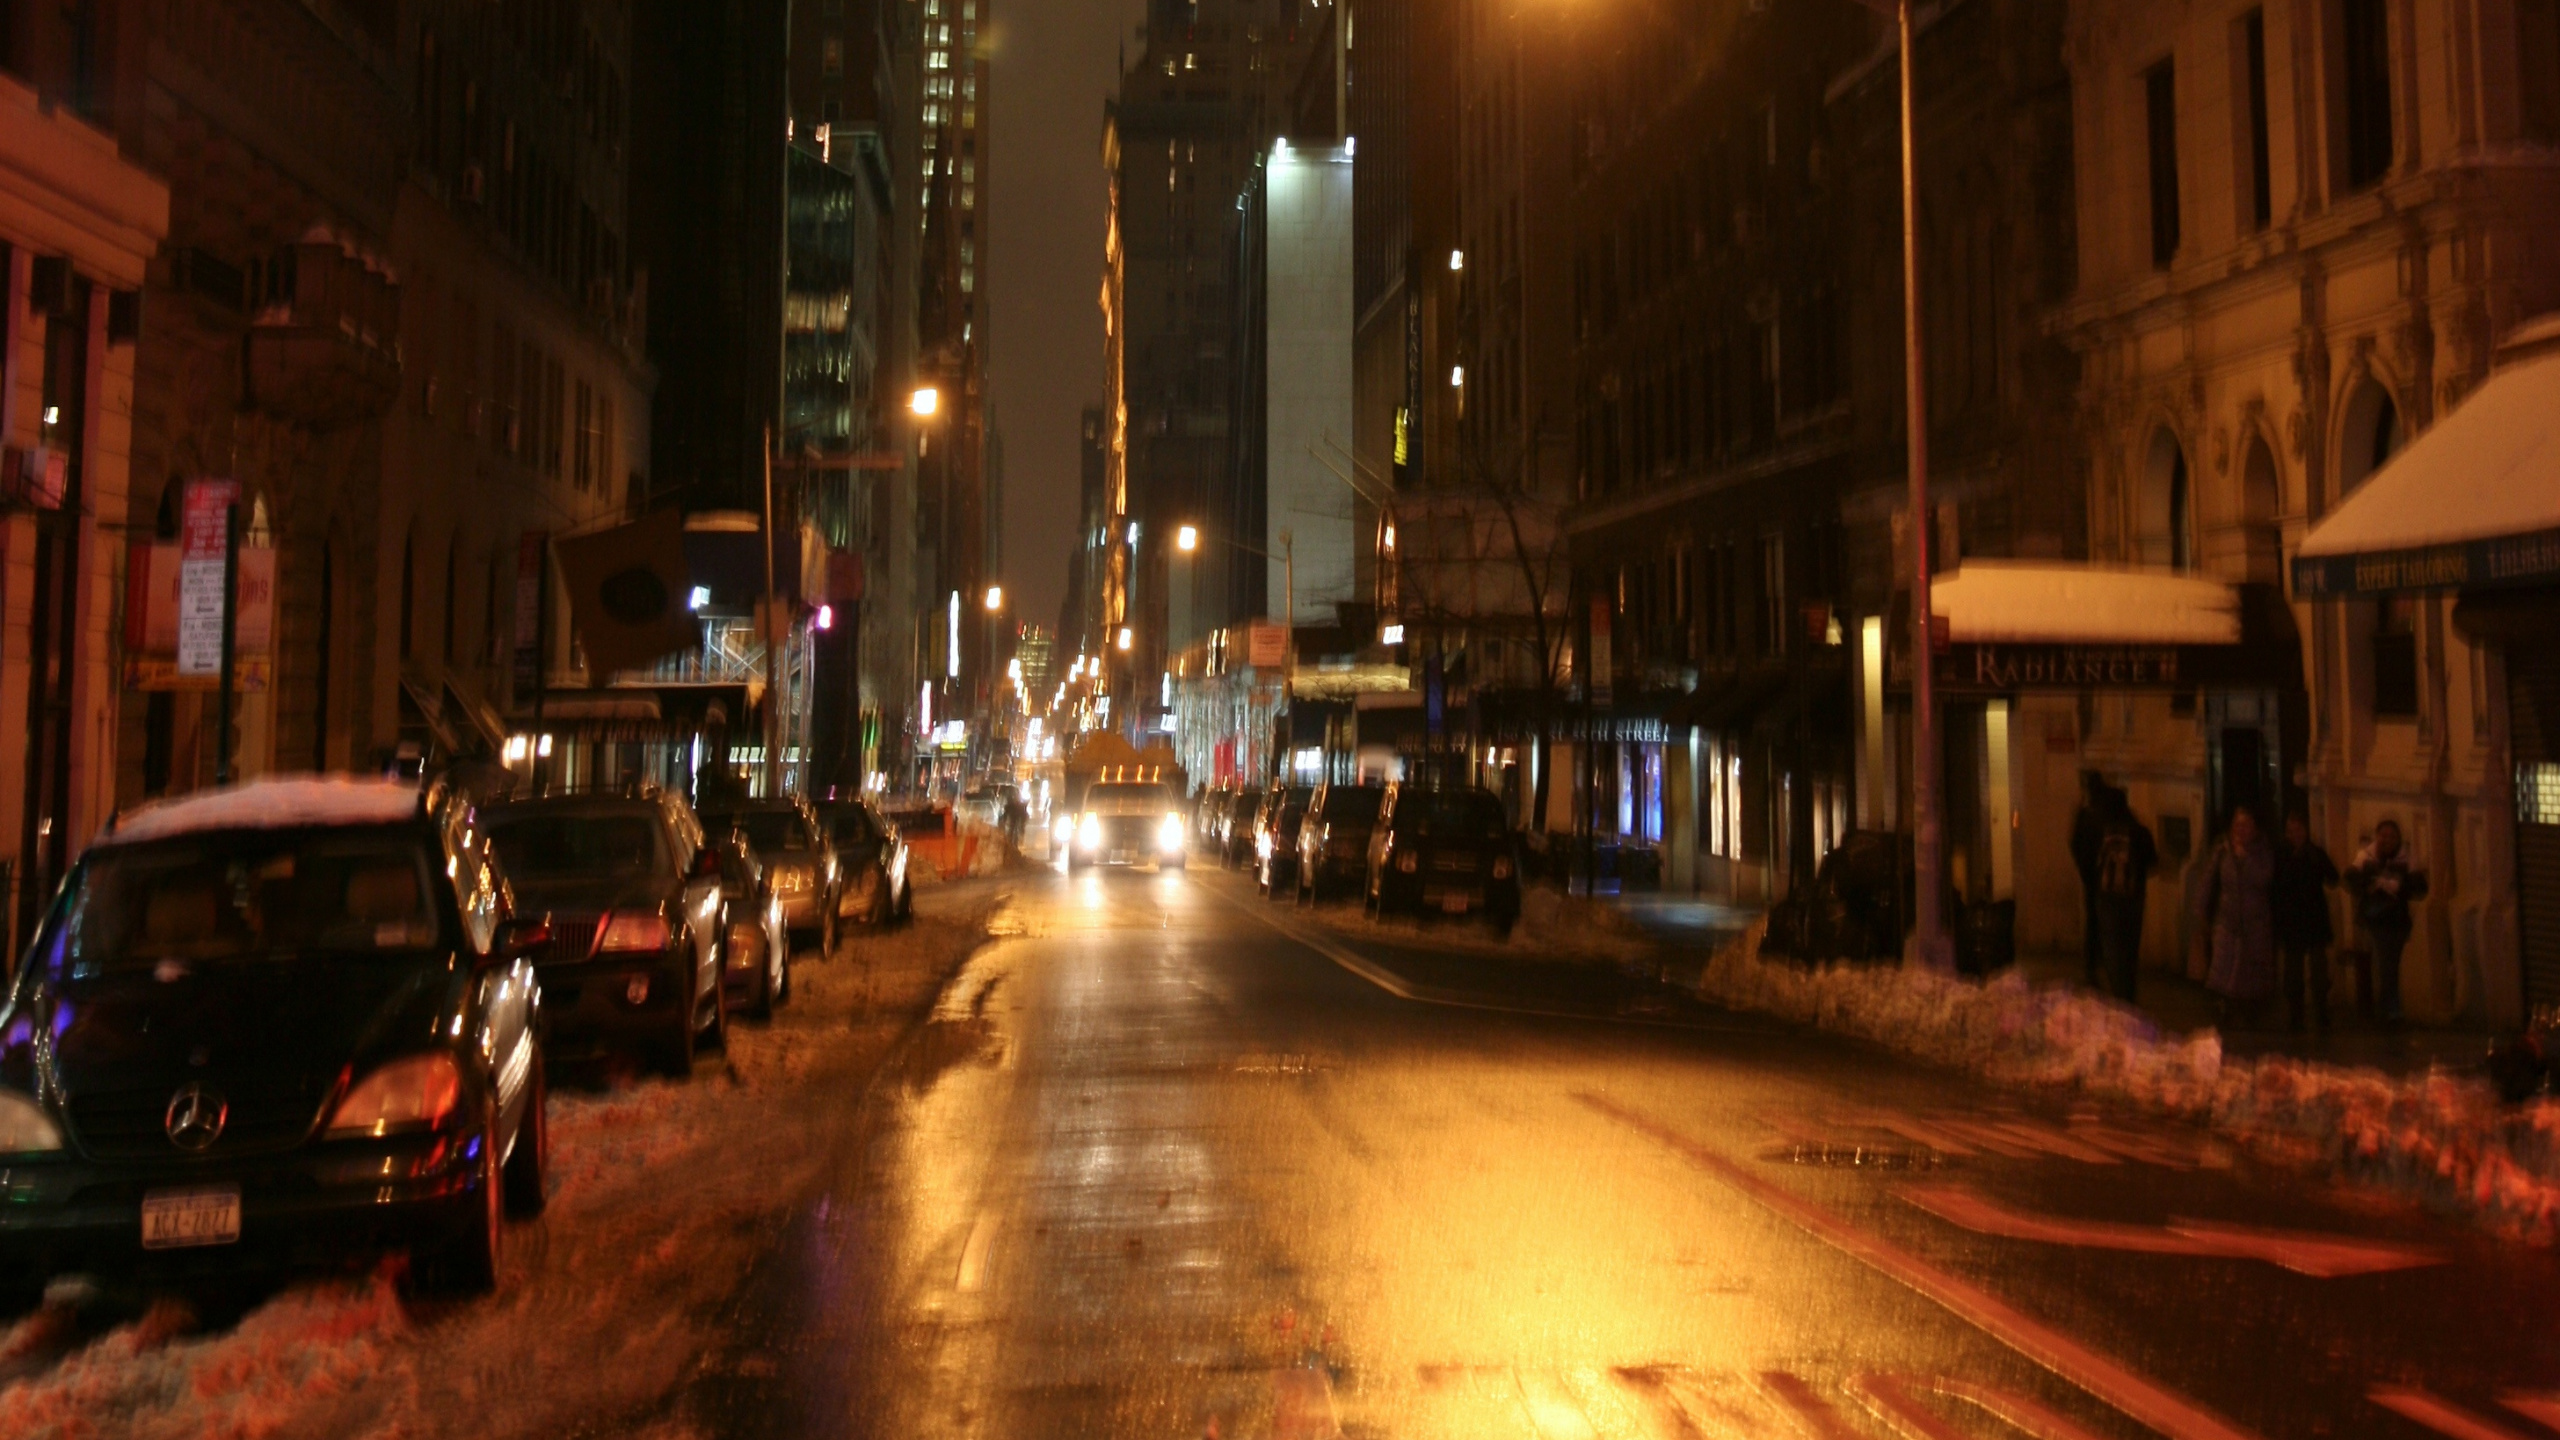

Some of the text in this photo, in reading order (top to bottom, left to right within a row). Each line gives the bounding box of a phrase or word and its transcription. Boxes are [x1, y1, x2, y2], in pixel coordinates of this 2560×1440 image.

[1394, 408, 1407, 466] Hertz
[2355, 564, 2398, 592] EXPERT
[2400, 556, 2468, 589] TAILORING
[1975, 649, 2147, 688] RADIANCE
